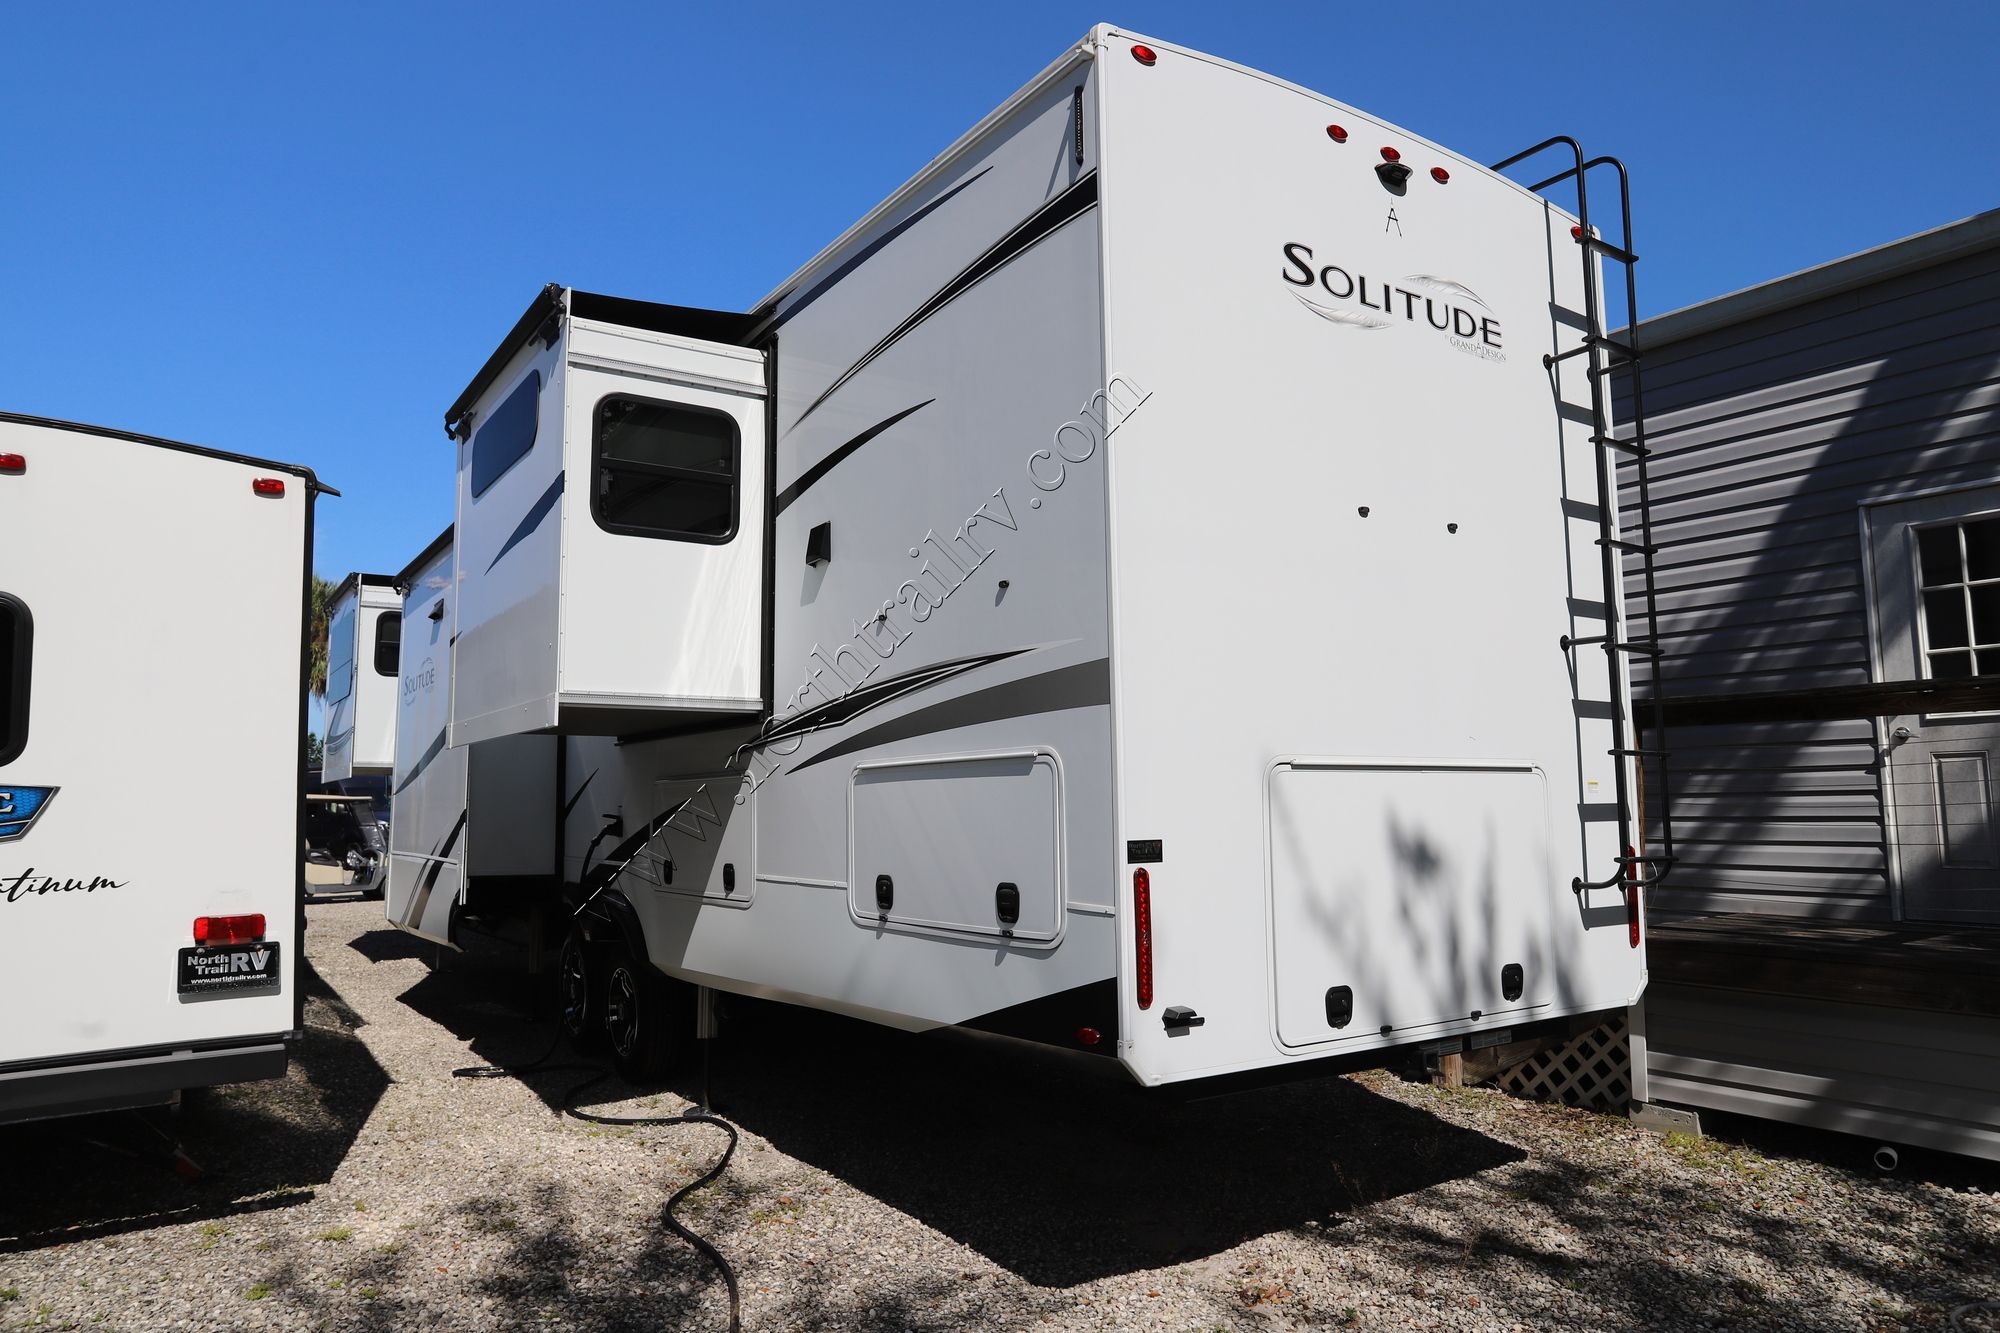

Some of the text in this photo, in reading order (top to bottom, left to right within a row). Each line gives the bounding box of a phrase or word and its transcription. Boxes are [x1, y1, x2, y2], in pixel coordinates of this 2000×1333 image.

[1282, 242, 1503, 349] SOLITUDE
[1449, 336, 1477, 352] GRAND
[1482, 346, 1507, 361] DESIGN
[404, 668, 435, 696] SOLITUDE
[187, 954, 229, 965] North
[195, 963, 229, 974] Trail
[230, 950, 271, 973] RV
